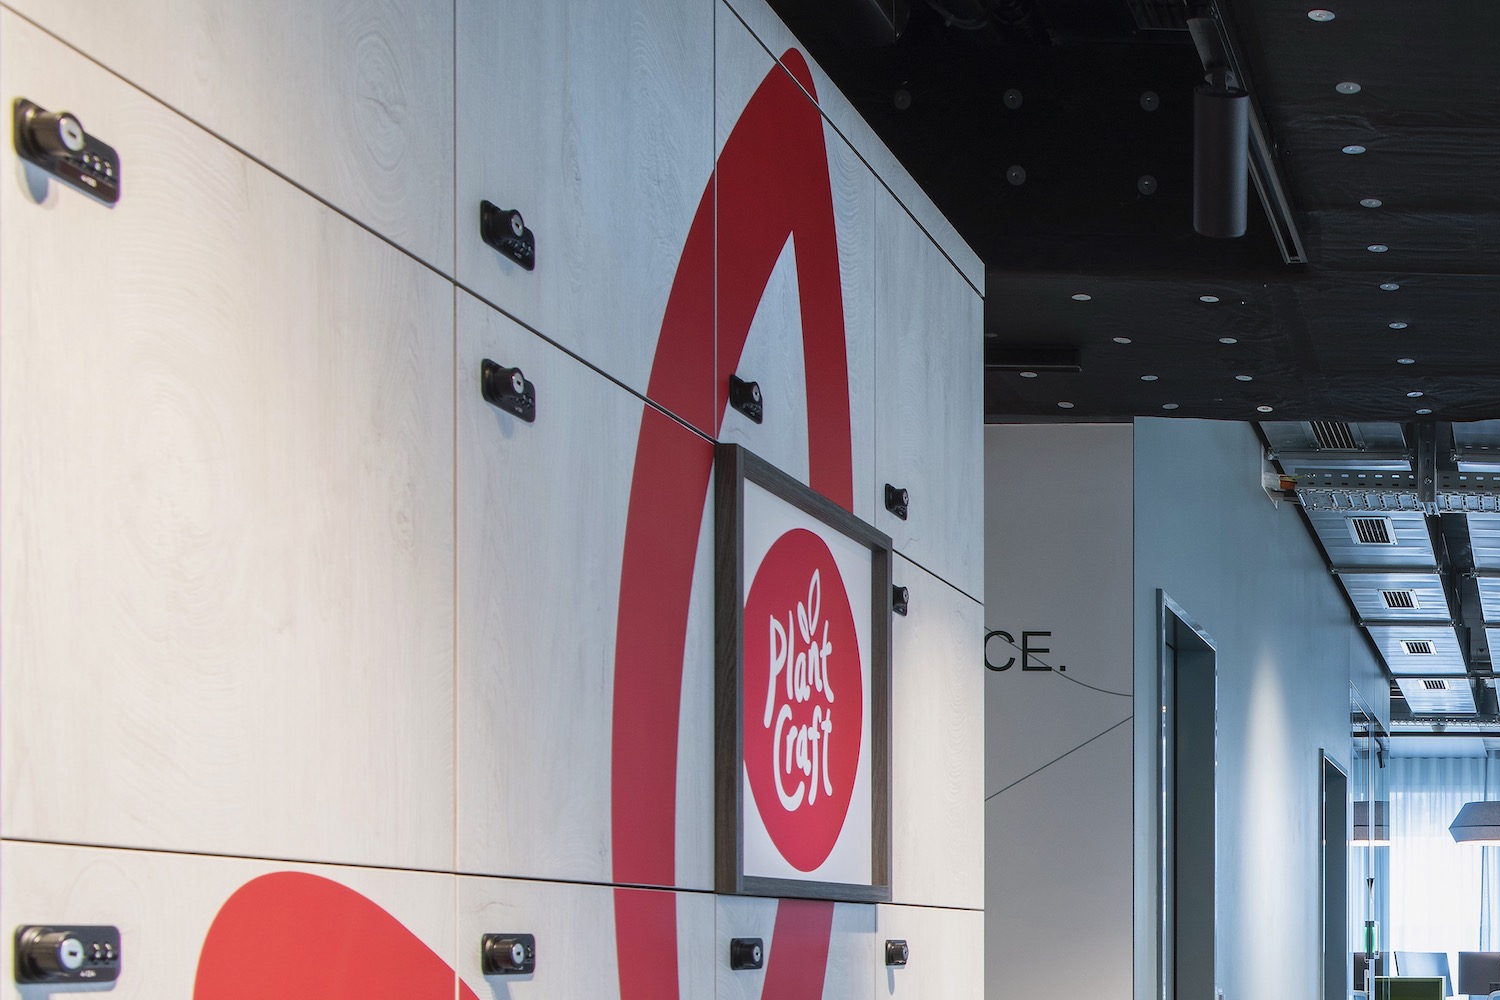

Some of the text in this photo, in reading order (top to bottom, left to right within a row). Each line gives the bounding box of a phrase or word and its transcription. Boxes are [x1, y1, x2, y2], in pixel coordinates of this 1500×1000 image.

[764, 608, 834, 729] Plant
[984, 630, 1066, 672] CE.
[773, 703, 833, 812] Craft
